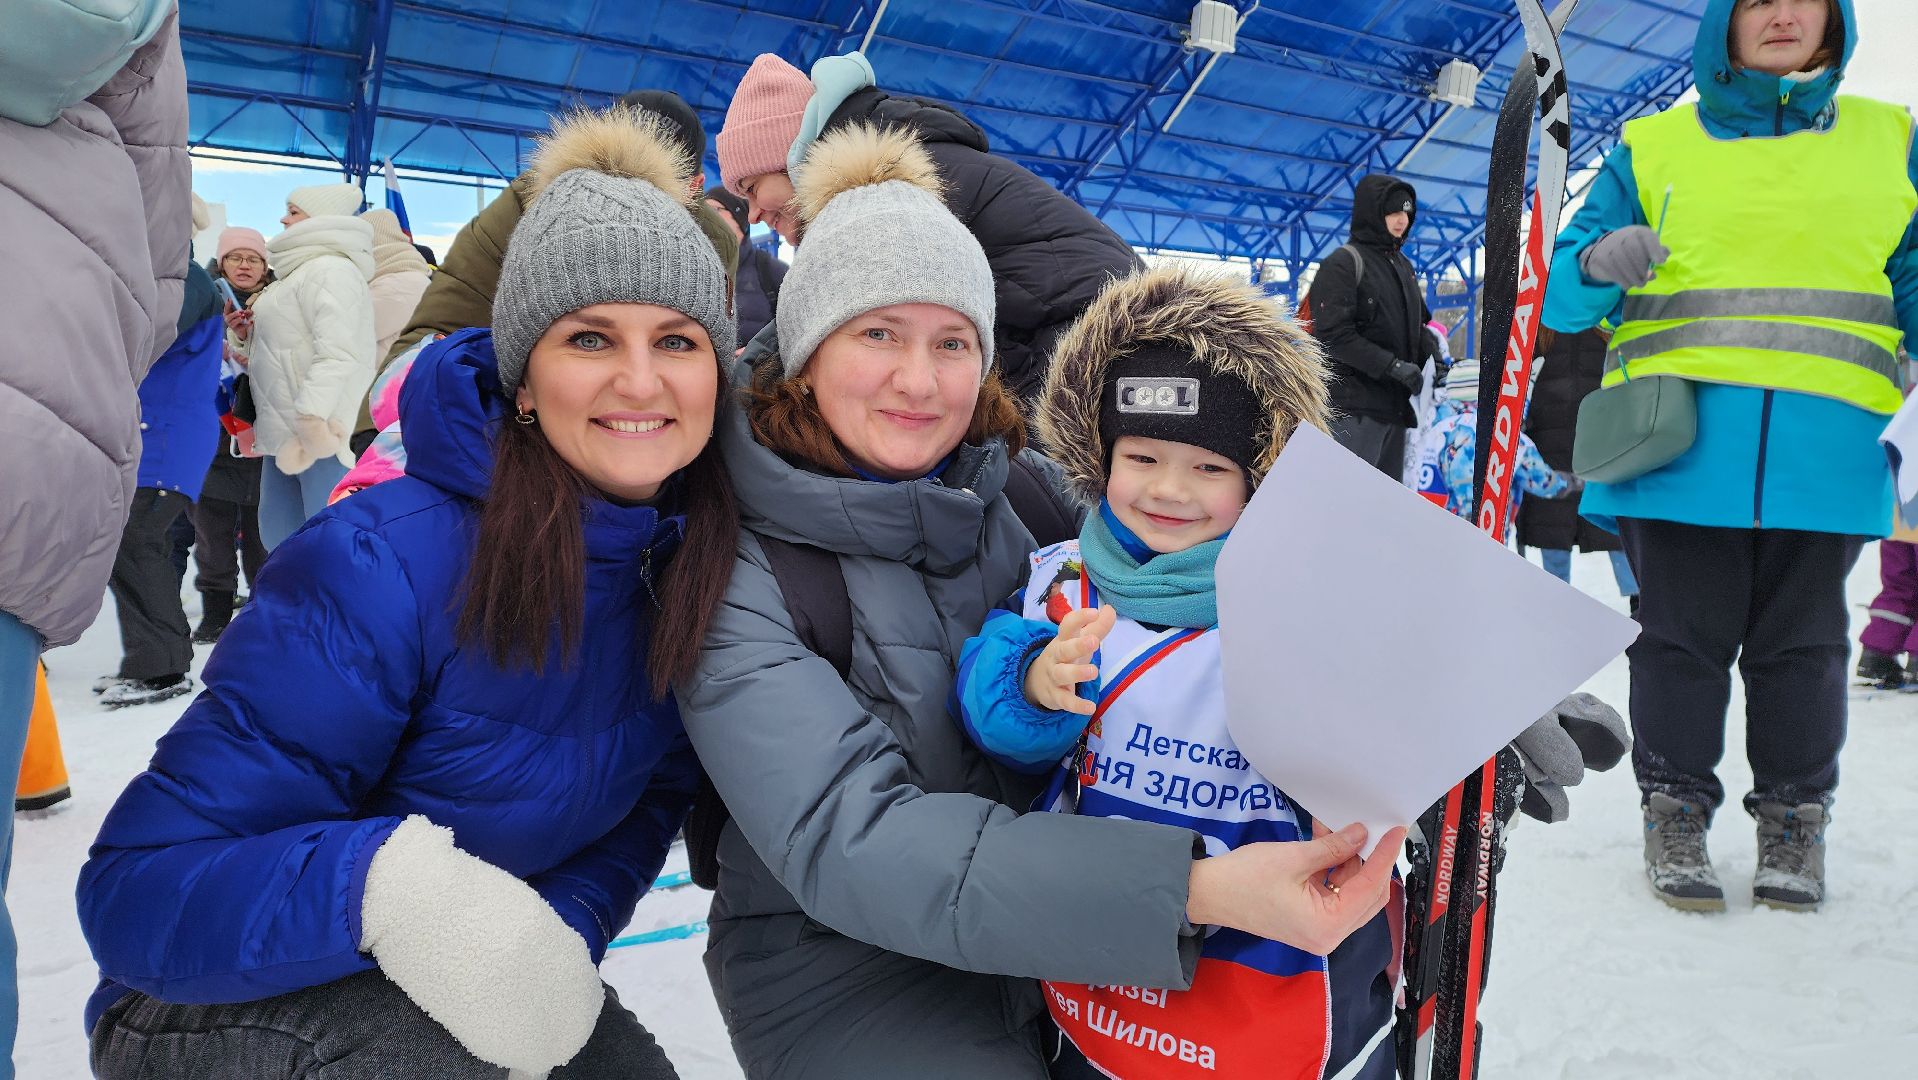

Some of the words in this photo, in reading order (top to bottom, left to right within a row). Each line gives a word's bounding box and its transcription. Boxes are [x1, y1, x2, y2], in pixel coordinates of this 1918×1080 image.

[1121, 386, 1192, 407] COOL
[1479, 253, 1539, 538] ORDWAY
[1436, 824, 1459, 905] NORDWAY
[1476, 811, 1495, 900] NORDWAY
[1087, 1000, 1217, 1071] Шилова
